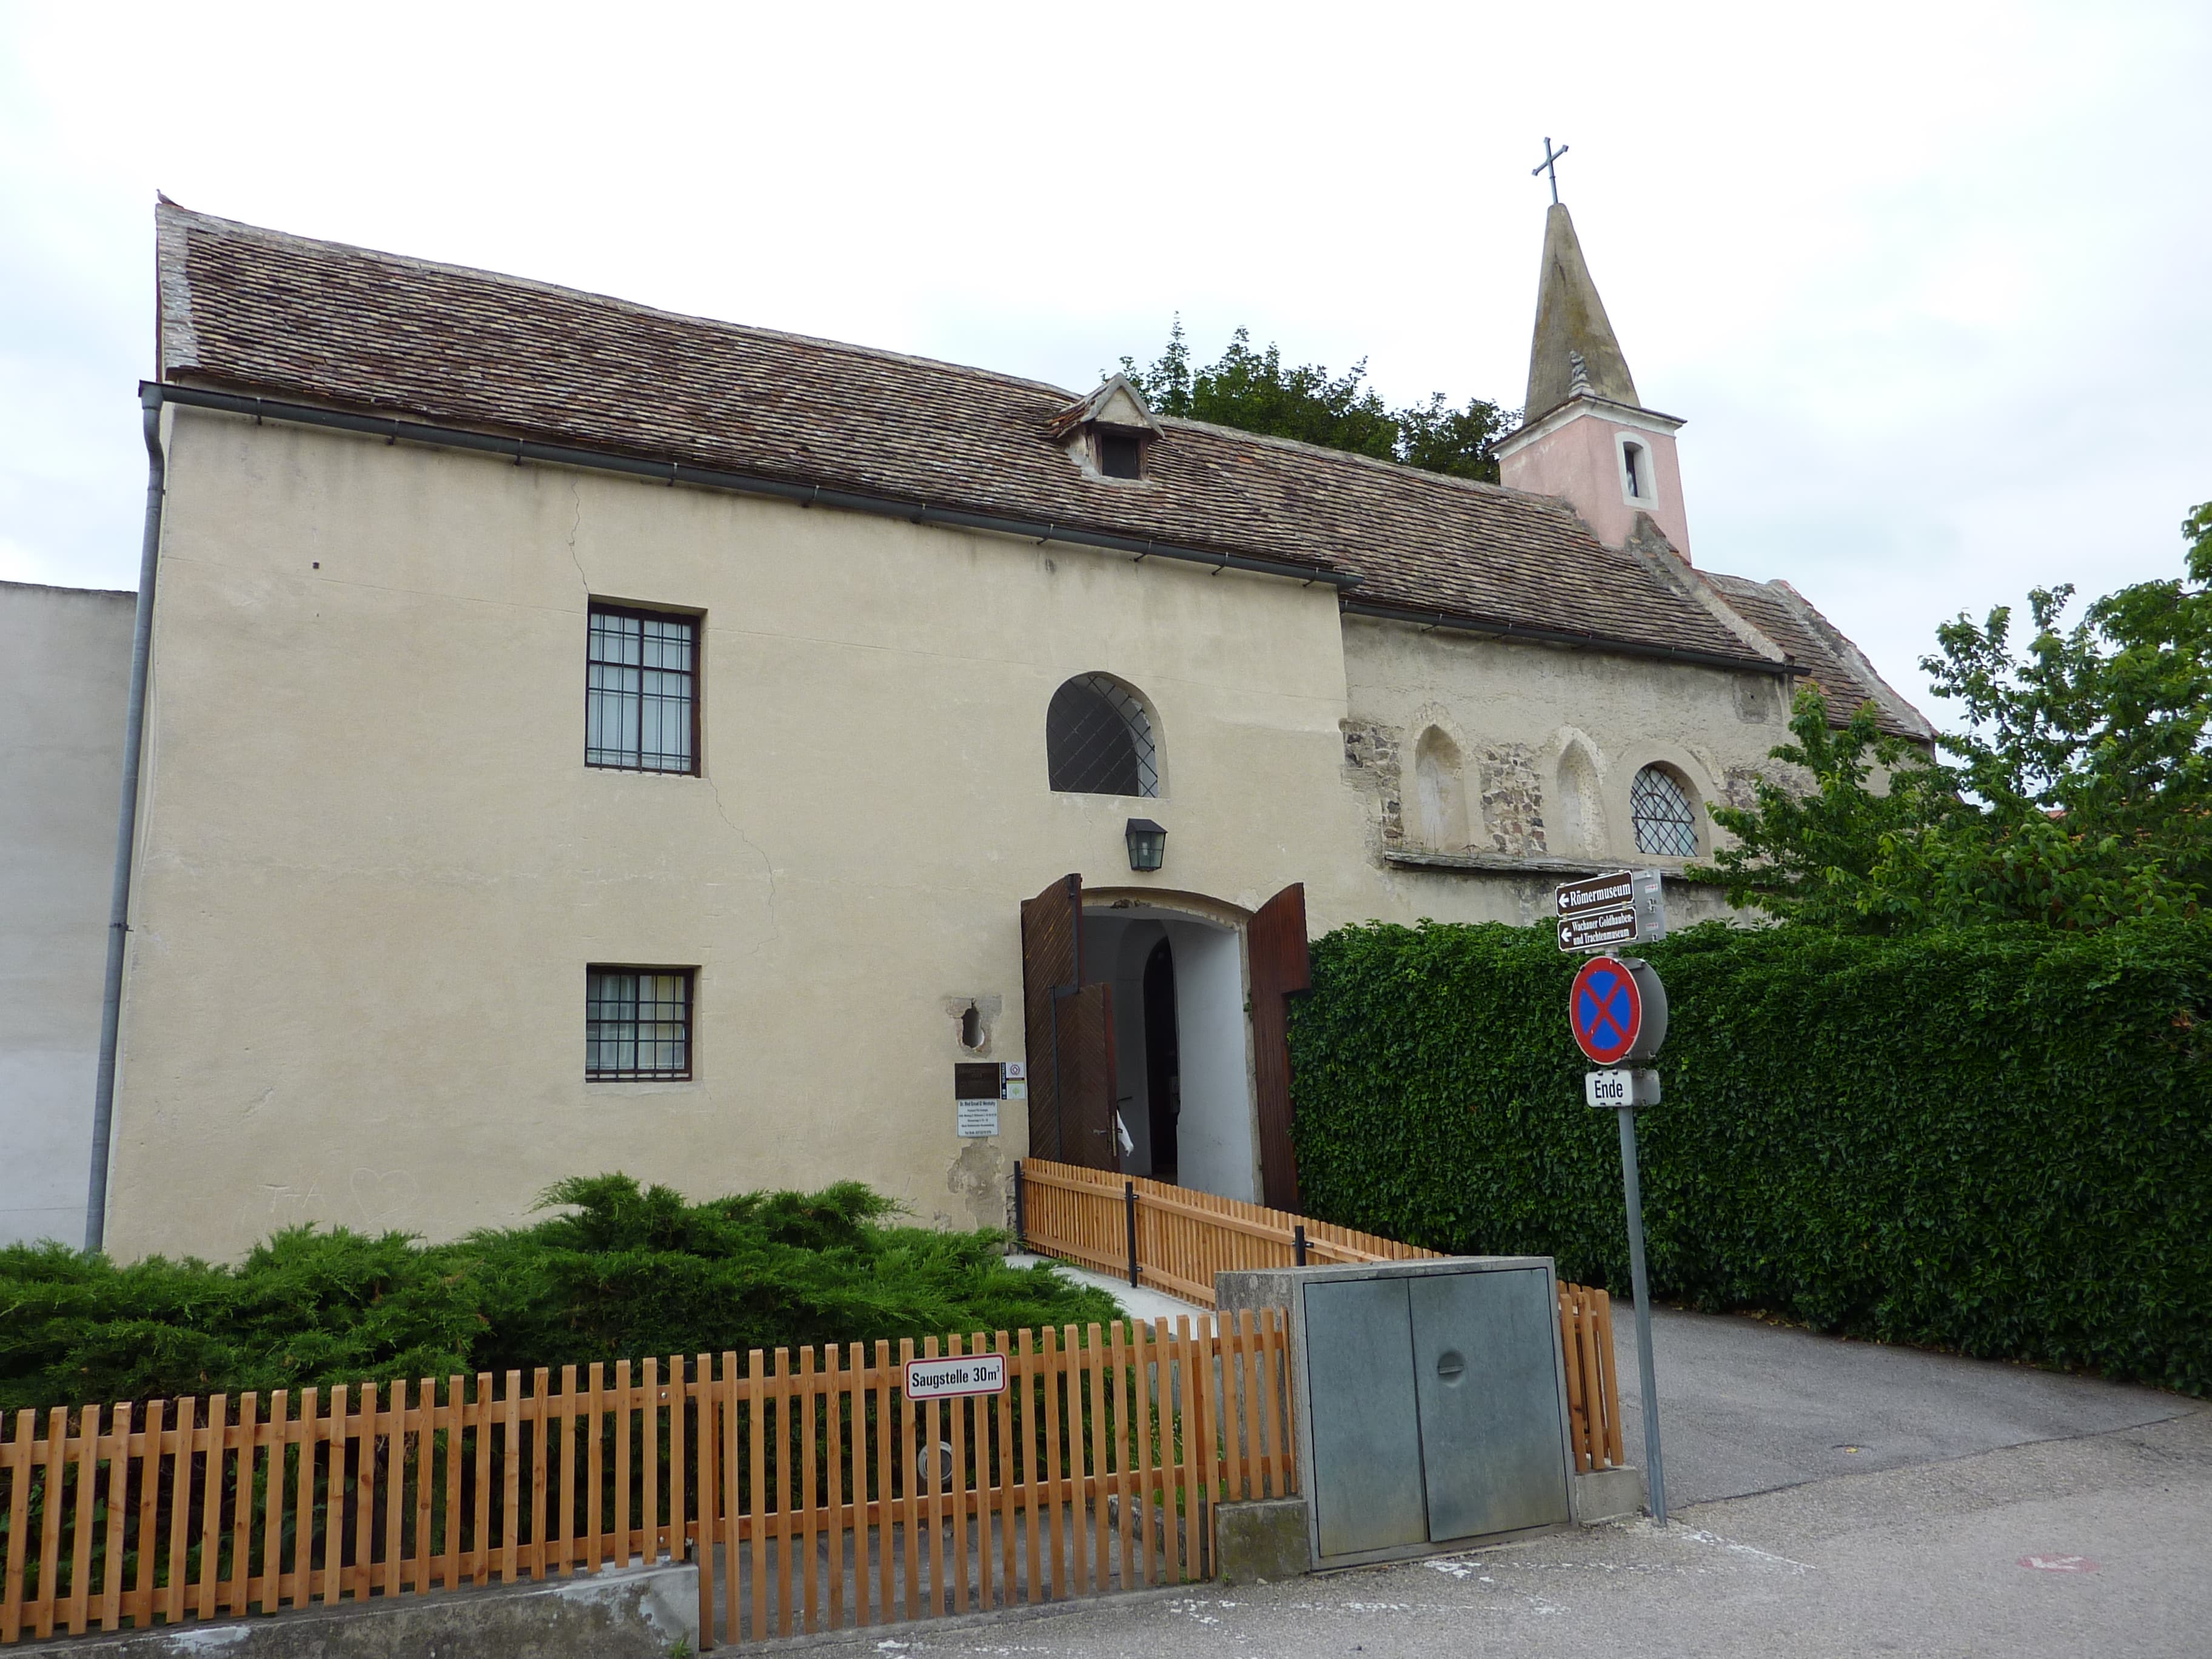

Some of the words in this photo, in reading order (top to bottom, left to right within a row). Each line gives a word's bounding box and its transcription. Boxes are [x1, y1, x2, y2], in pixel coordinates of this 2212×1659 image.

[1569, 883, 1631, 907] Römermuseum
[1572, 920, 1598, 932] Wachauer
[1598, 913, 1634, 928] Goldhauben-
[1573, 934, 1584, 946] und
[1584, 928, 1630, 943] Trachtenmuseum
[1594, 1079, 1623, 1099] Ende
[912, 1369, 969, 1389] Saugstelle
